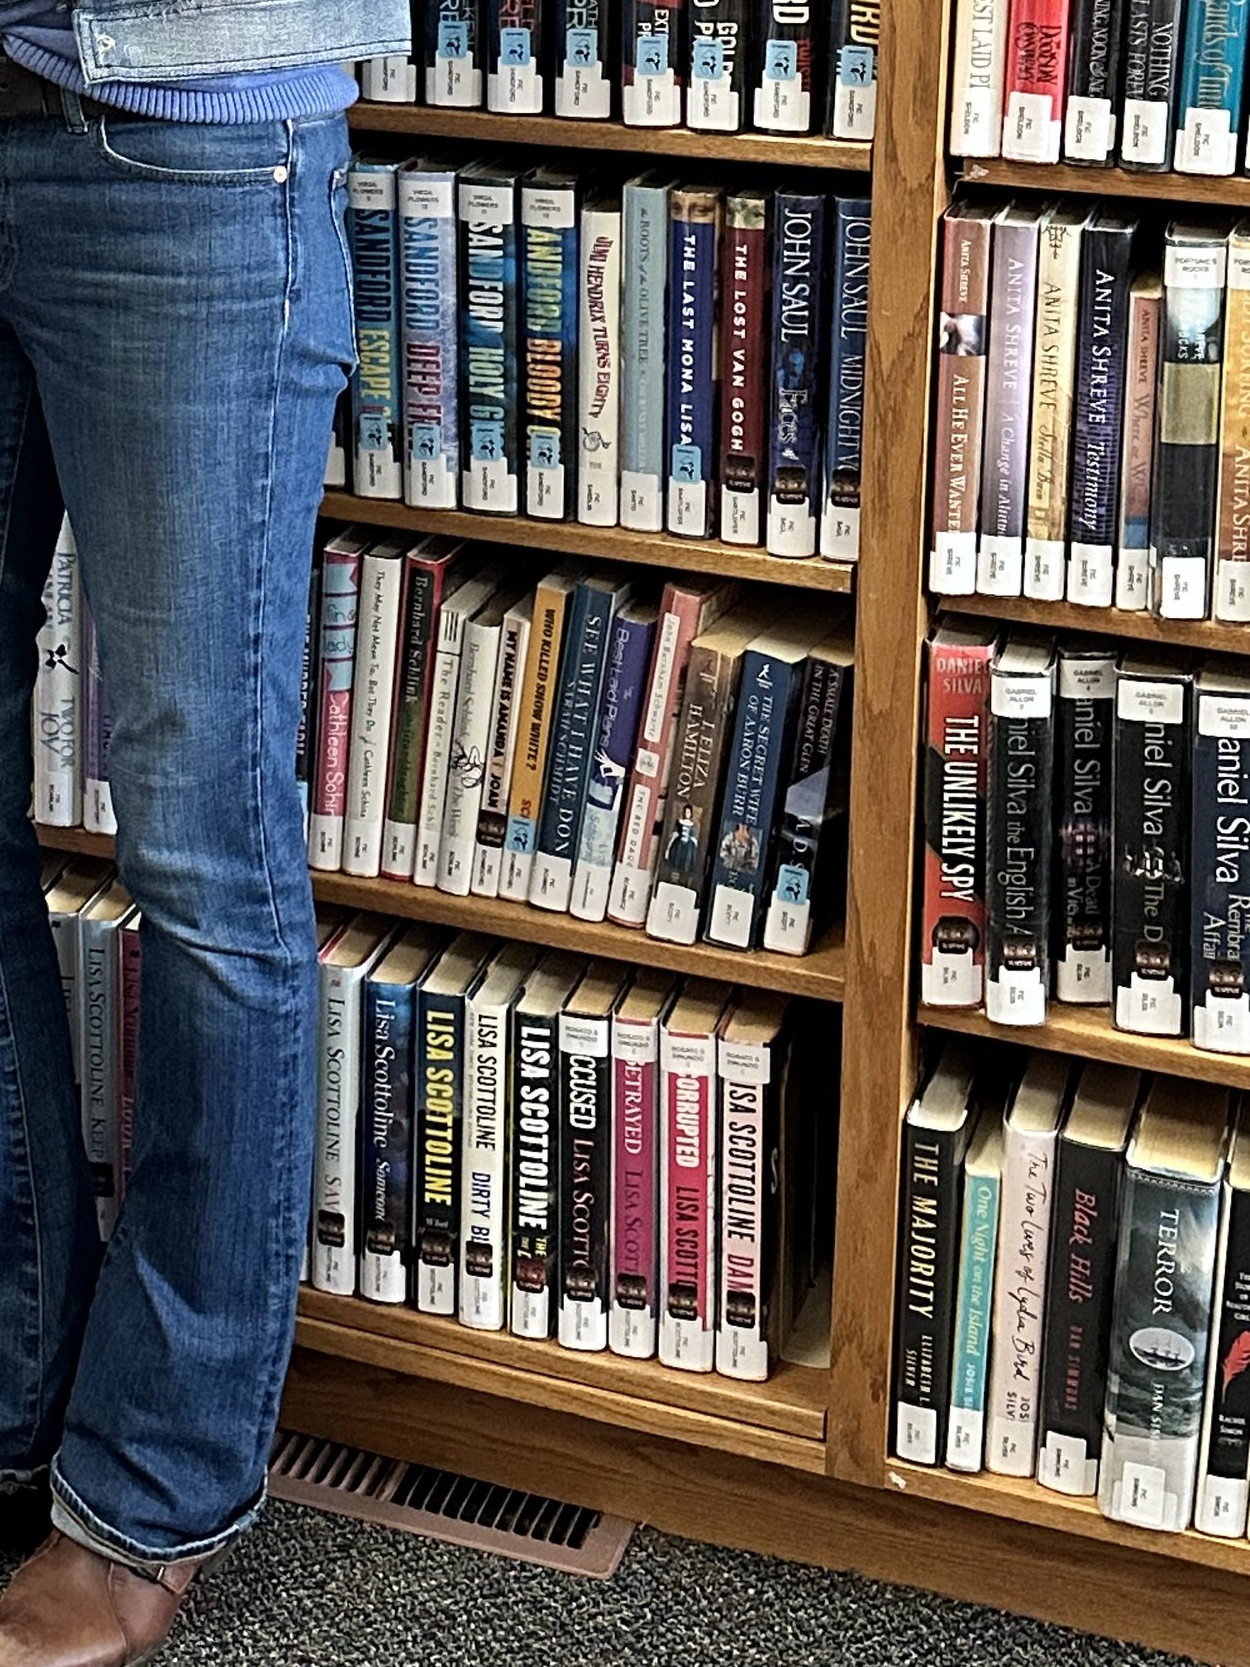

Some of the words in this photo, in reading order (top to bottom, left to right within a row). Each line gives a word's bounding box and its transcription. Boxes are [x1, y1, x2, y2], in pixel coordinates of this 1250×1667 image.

[682, 235, 696, 271] THE
[733, 244, 748, 280] THE
[783, 209, 813, 279] JOHN
[681, 282, 695, 329] LAST
[732, 291, 747, 338] LOST
[780, 284, 810, 343] SAUL
[1093, 268, 1114, 338] ANITA
[681, 338, 695, 393] MONA
[732, 349, 746, 387] VAN
[1087, 345, 1111, 424] SHREVE
[679, 404, 693, 445] LISA
[731, 398, 745, 450] GOGH
[1081, 441, 1105, 530] Testimony
[541, 609, 555, 637] WHO
[537, 639, 551, 683] KILLED
[532, 685, 546, 720] SNOW
[525, 722, 541, 771] WHITE?
[944, 715, 979, 754] THE
[941, 761, 977, 858] UNLIKELY
[941, 863, 974, 901] SPY
[375, 999, 394, 1041] Lisa
[427, 1011, 456, 1060] LISA
[373, 1044, 394, 1148] Scottoline
[424, 1066, 453, 1205] SCOTTOLINE
[912, 1143, 940, 1185] THE
[1070, 1189, 1097, 1245] Black
[908, 1196, 937, 1318] MAJORITY
[1067, 1253, 1092, 1303] Hills
[1153, 1209, 1179, 1315] TERROR
